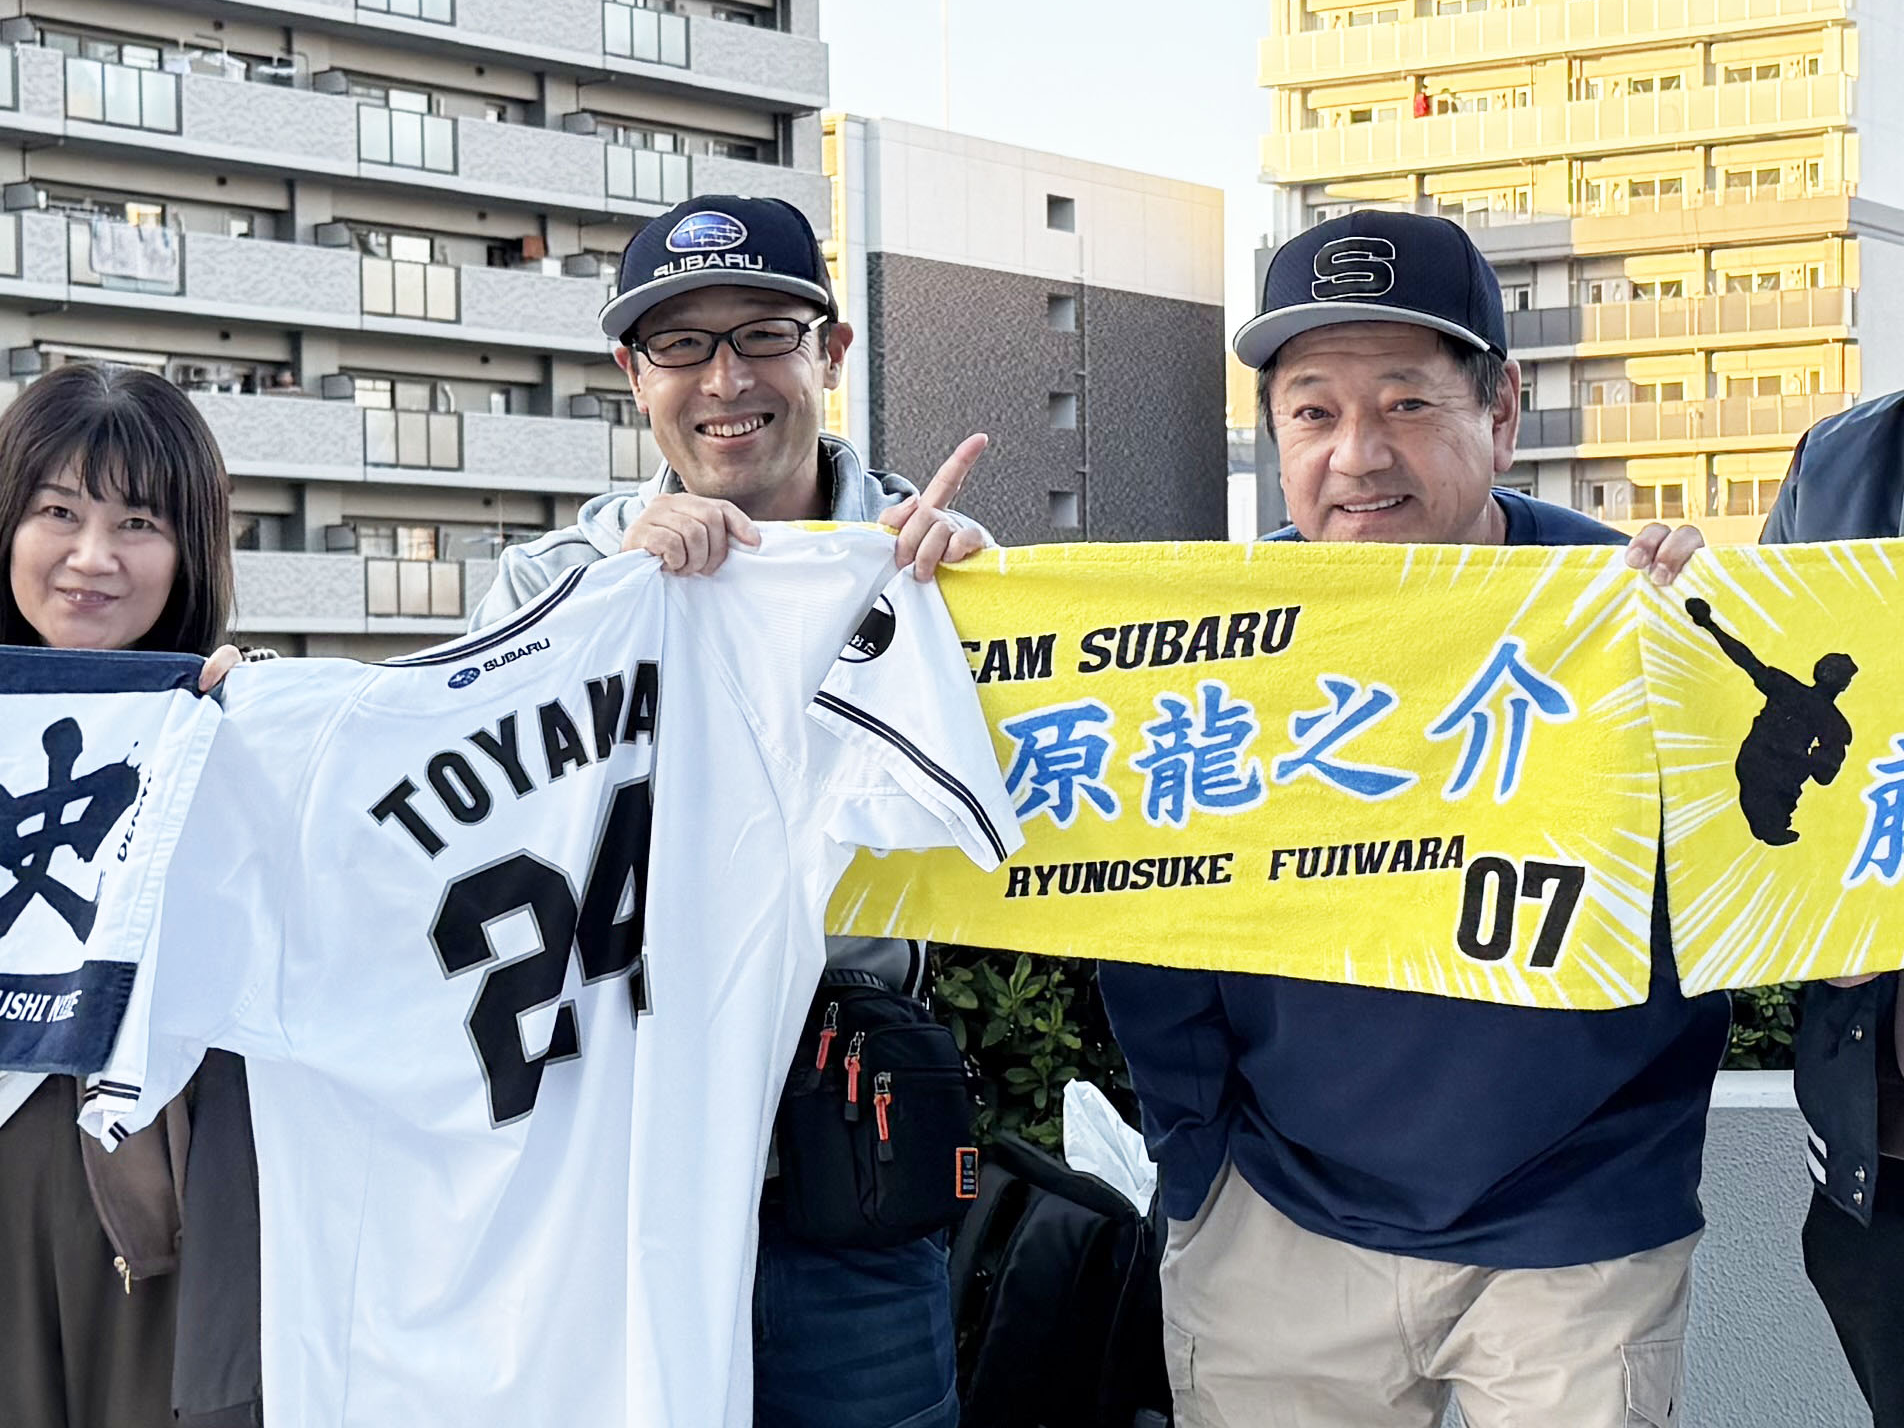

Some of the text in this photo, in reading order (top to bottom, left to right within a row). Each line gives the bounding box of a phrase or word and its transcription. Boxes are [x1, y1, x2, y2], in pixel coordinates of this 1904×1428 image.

[1311, 236, 1395, 301] S
[483, 637, 551, 672] SUBARU
[960, 605, 1301, 683] EAM SUBARU
[1002, 639, 1574, 826] 原龍之介
[1004, 835, 1465, 898] RYUNOSUKE FUJIWARA
[1456, 856, 1586, 968] 07
[427, 773, 654, 1130] 24
